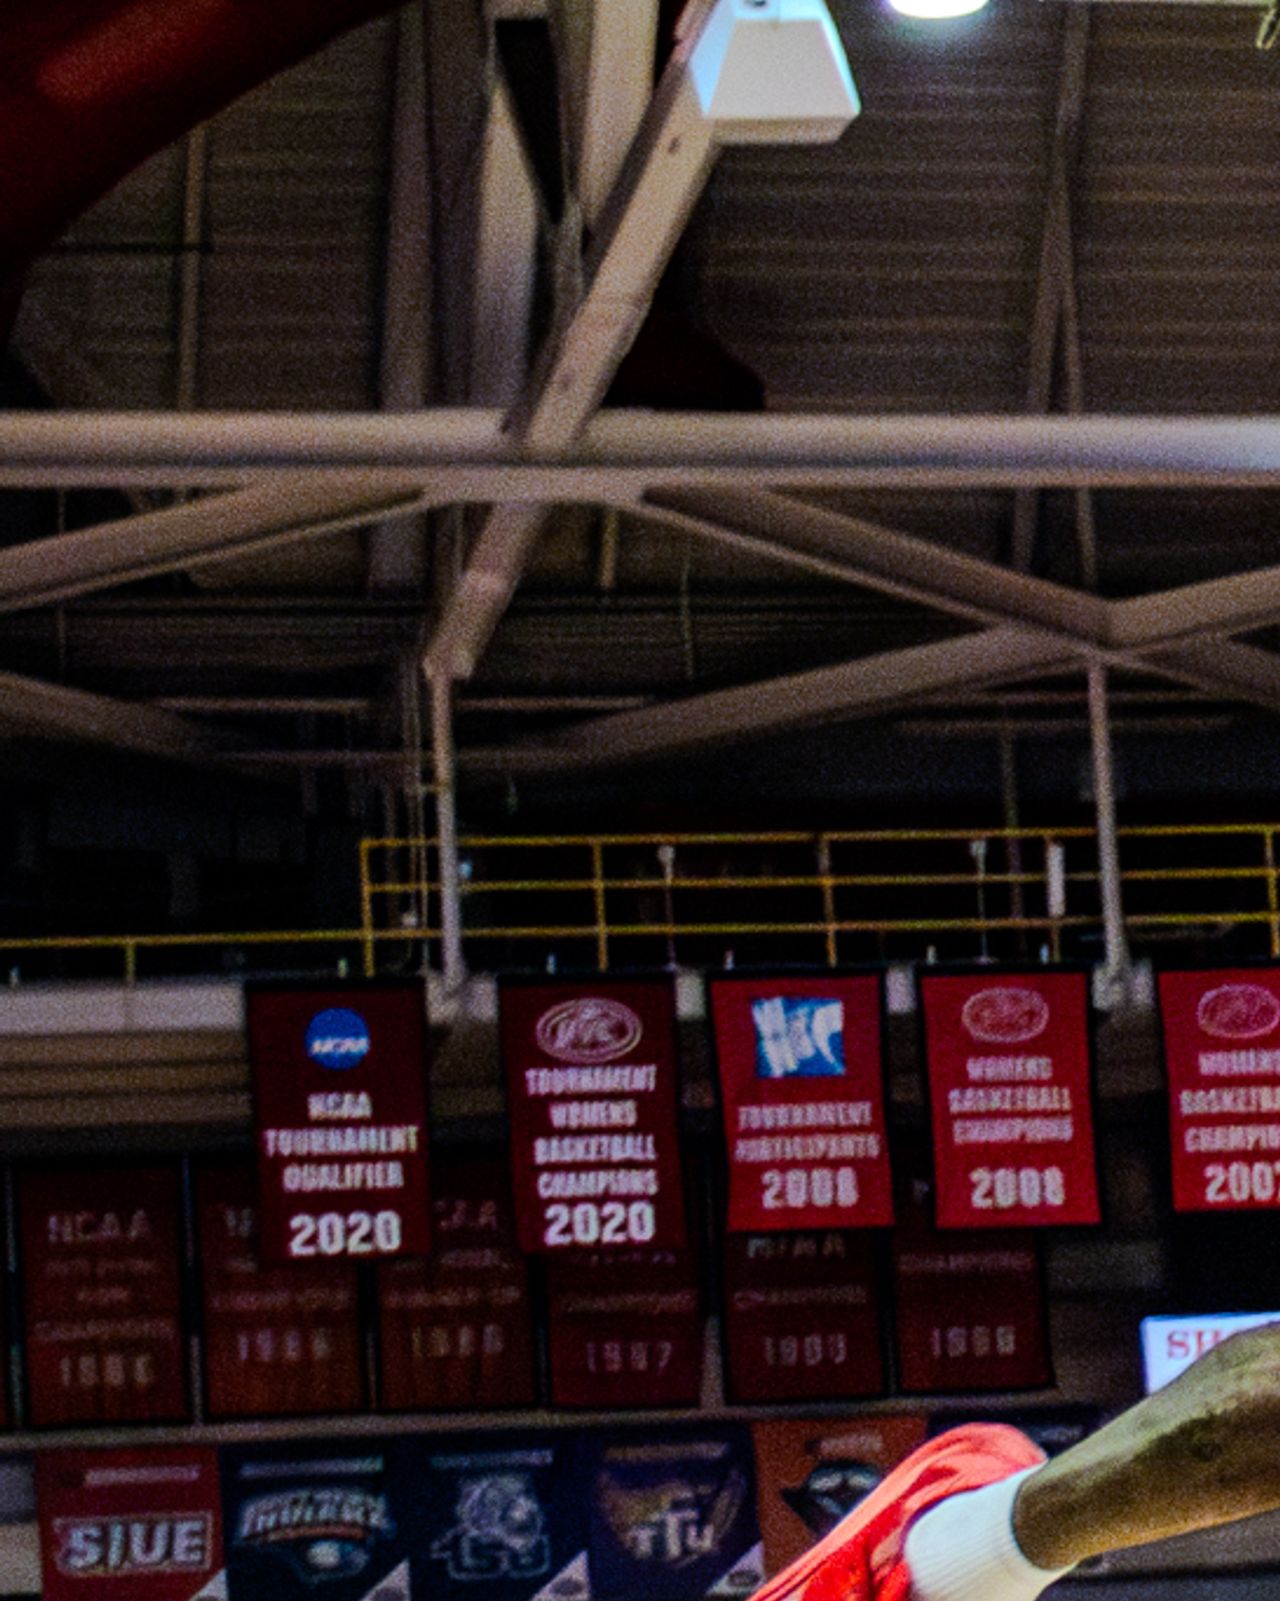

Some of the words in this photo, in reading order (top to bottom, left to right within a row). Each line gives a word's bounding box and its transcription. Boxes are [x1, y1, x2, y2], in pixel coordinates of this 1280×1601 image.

[265, 1126, 419, 1157] TOURNAMENT
[533, 1135, 657, 1165] BASKETBALL
[282, 1161, 404, 1192] QUALIFIER
[537, 1169, 659, 1199] CHAMPIONS
[288, 1210, 402, 1257] 2020
[544, 1200, 657, 1248] 2020
[64, 1517, 206, 1568] SIUE
